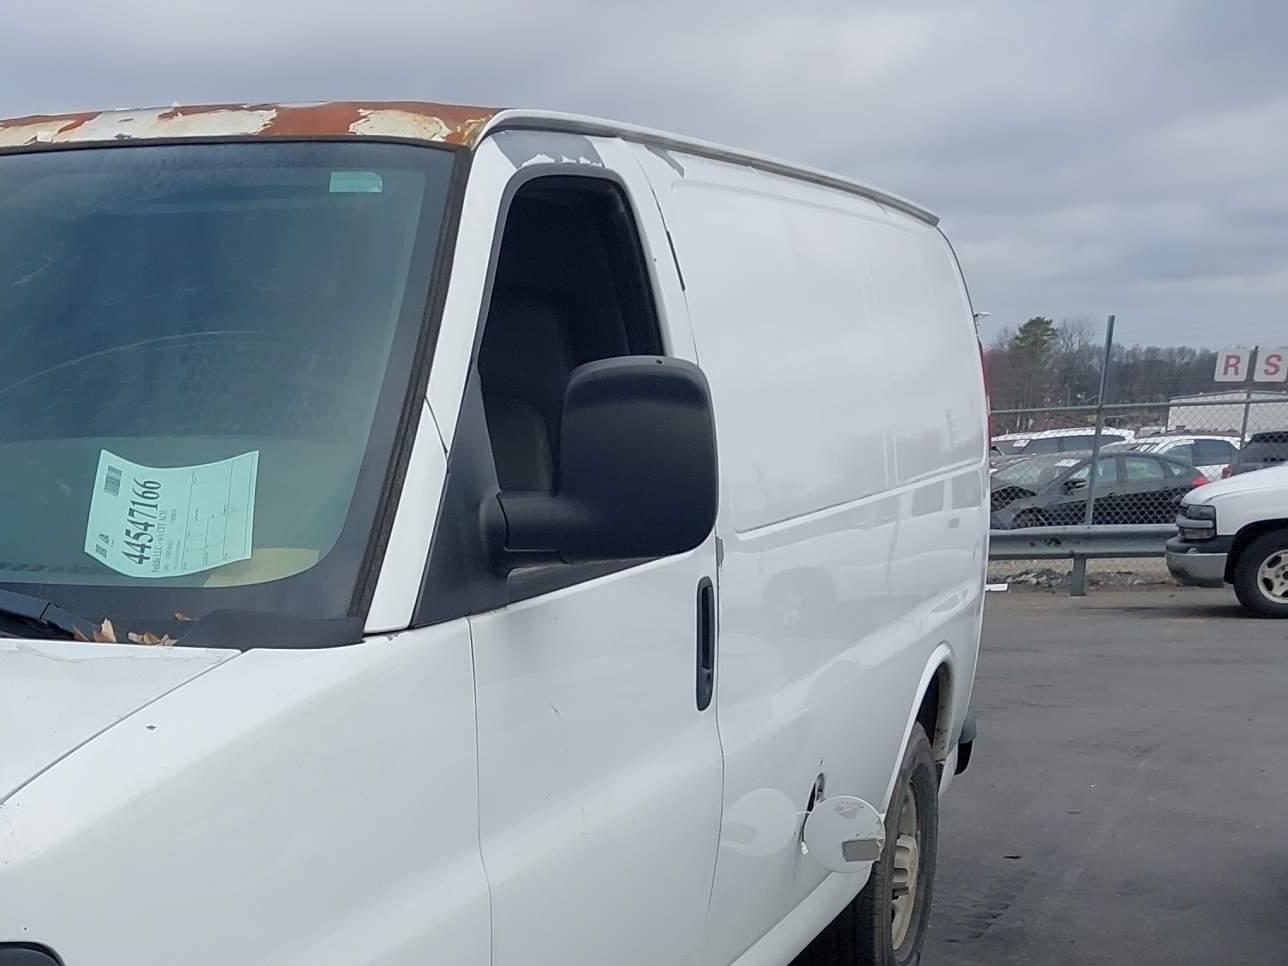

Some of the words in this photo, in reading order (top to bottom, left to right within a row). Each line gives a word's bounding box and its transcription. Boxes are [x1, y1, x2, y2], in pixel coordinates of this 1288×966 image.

[1223, 355, 1240, 376] R
[1264, 354, 1282, 376] S
[121, 477, 162, 565] 44547166
